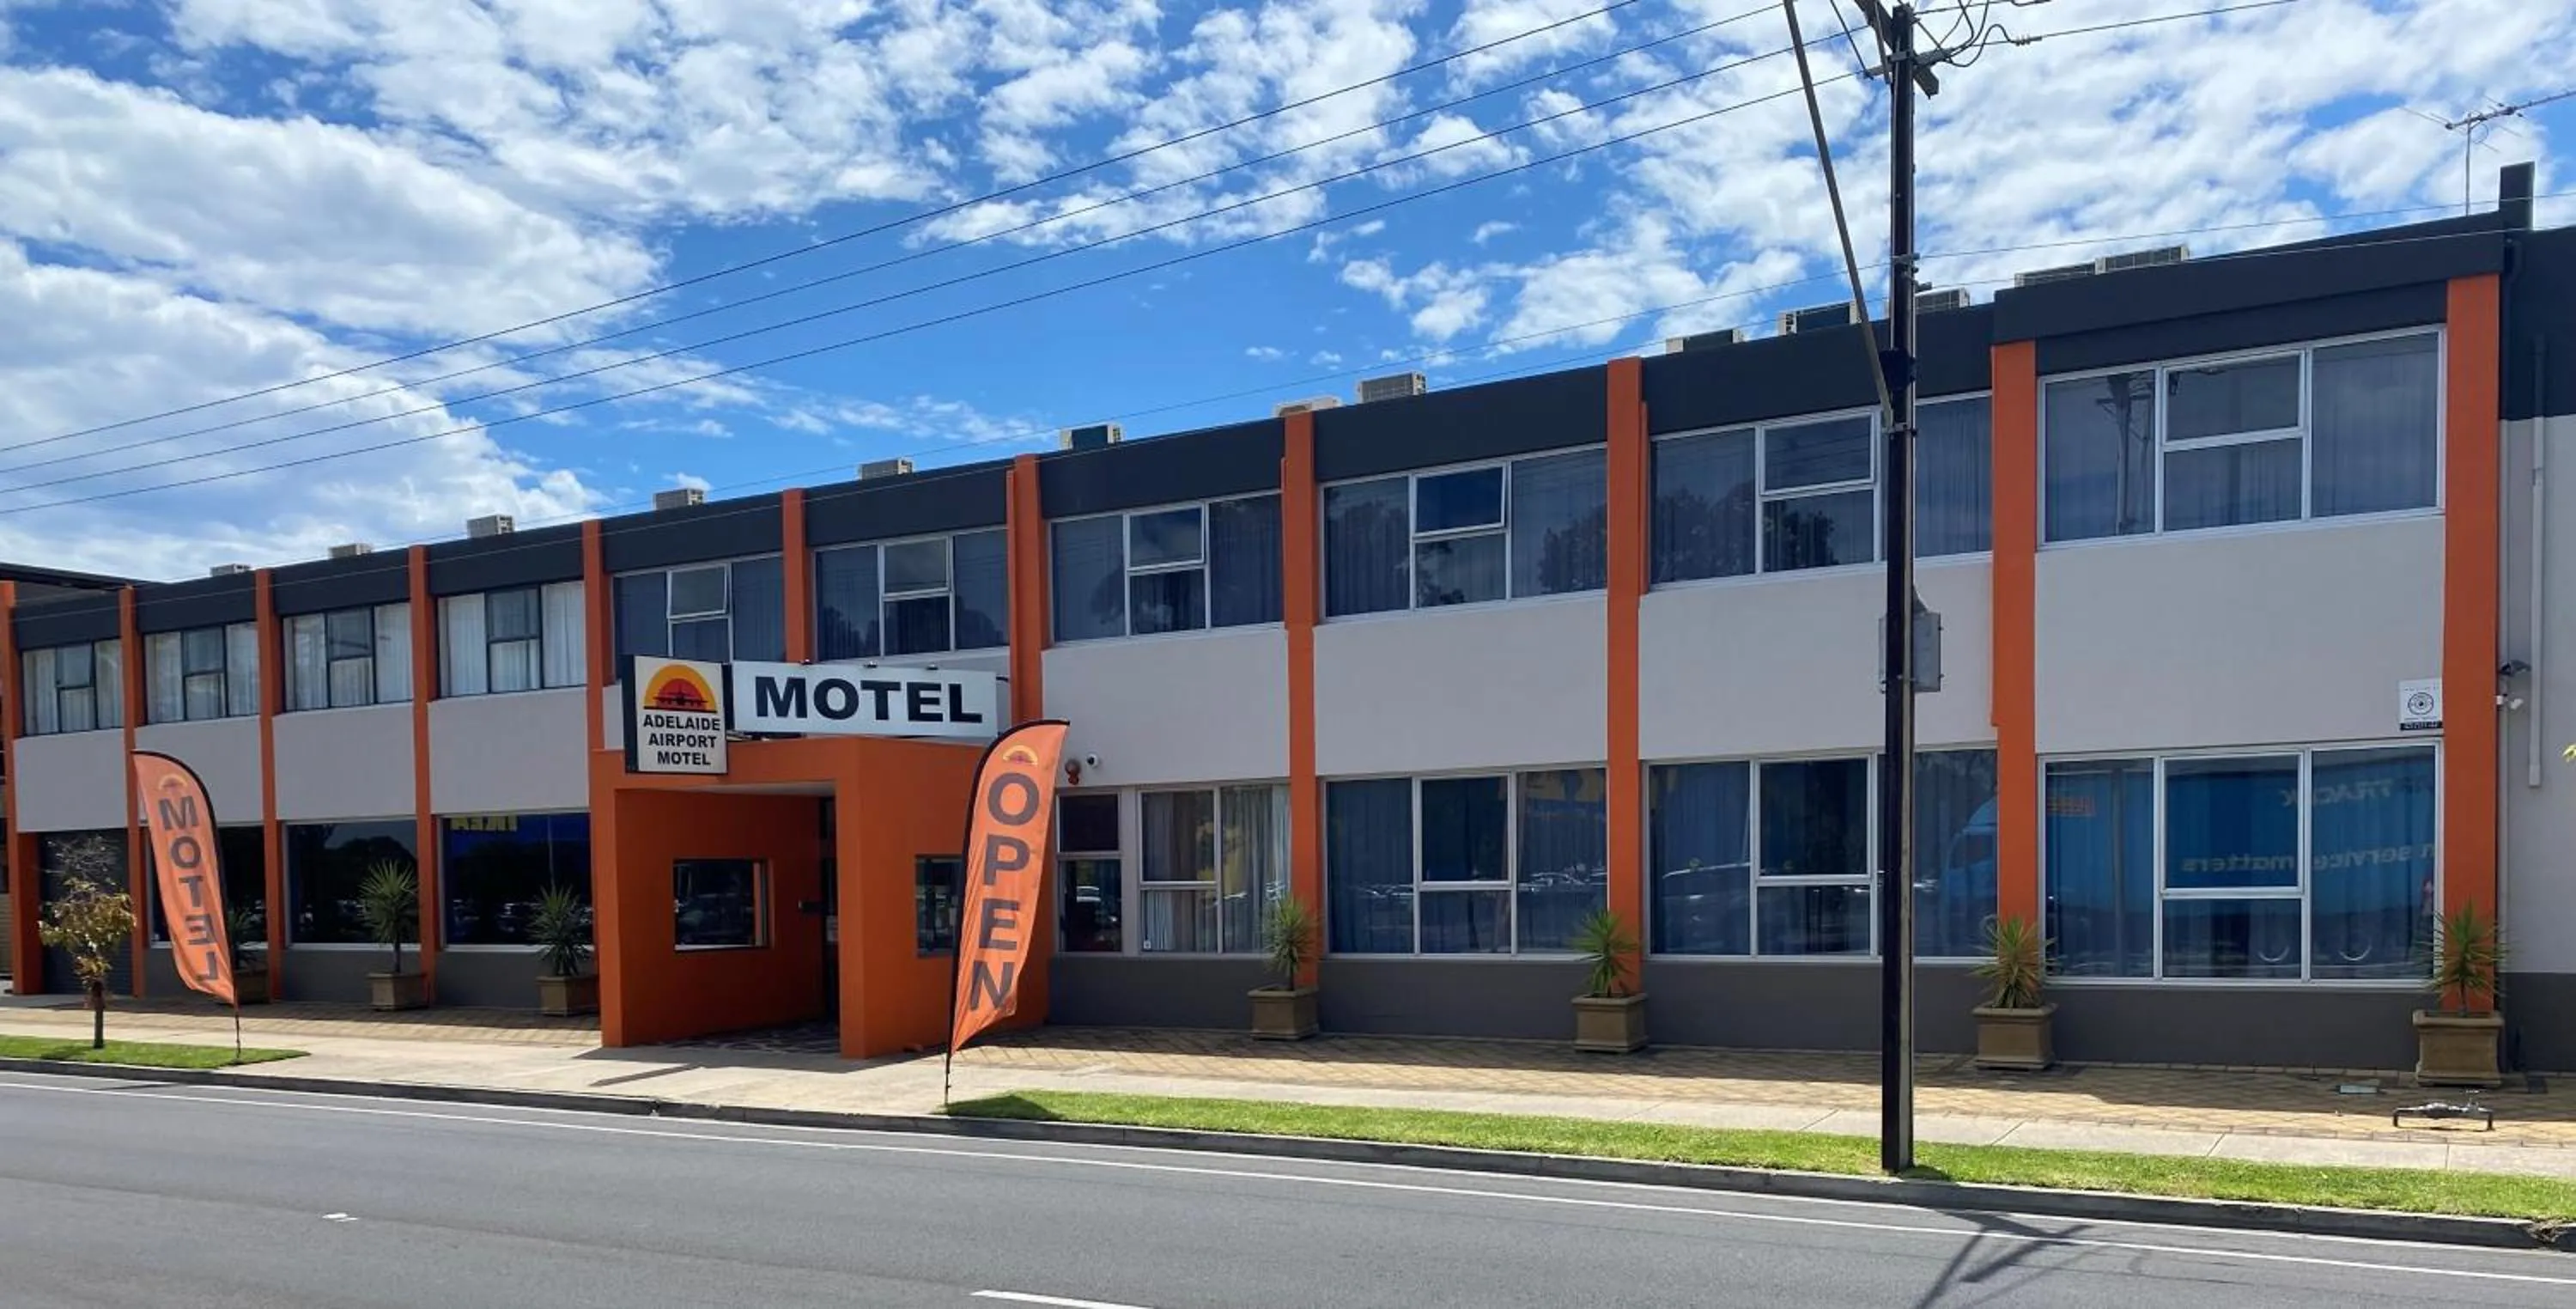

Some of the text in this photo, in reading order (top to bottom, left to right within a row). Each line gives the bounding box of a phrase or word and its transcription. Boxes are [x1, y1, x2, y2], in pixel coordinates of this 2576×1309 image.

[755, 676, 983, 723] MOTEL
[643, 714, 720, 731] ADELAIDE
[648, 733, 717, 748] AIRPORT
[657, 751, 711, 765] MOTEL
[969, 772, 1040, 1012] OPEN
